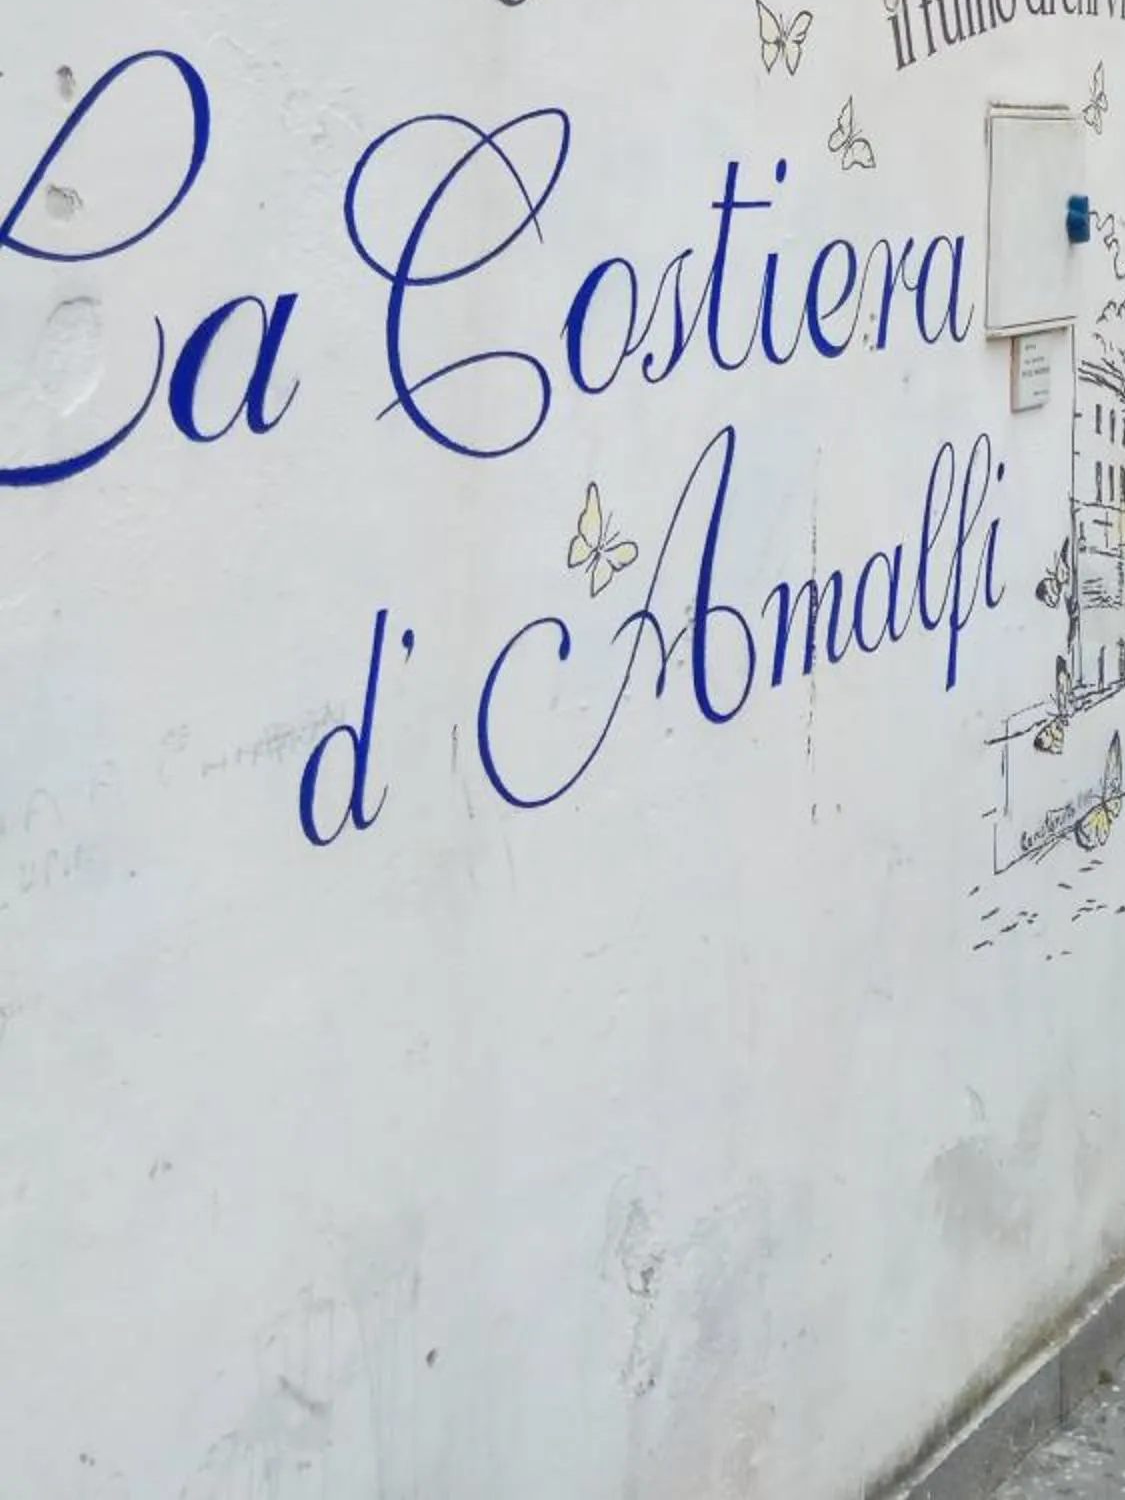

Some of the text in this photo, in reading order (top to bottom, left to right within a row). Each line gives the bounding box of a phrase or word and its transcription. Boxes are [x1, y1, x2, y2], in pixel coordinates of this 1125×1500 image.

[0, 49, 977, 487] La Costiera
[477, 425, 1008, 808] Amalfi
